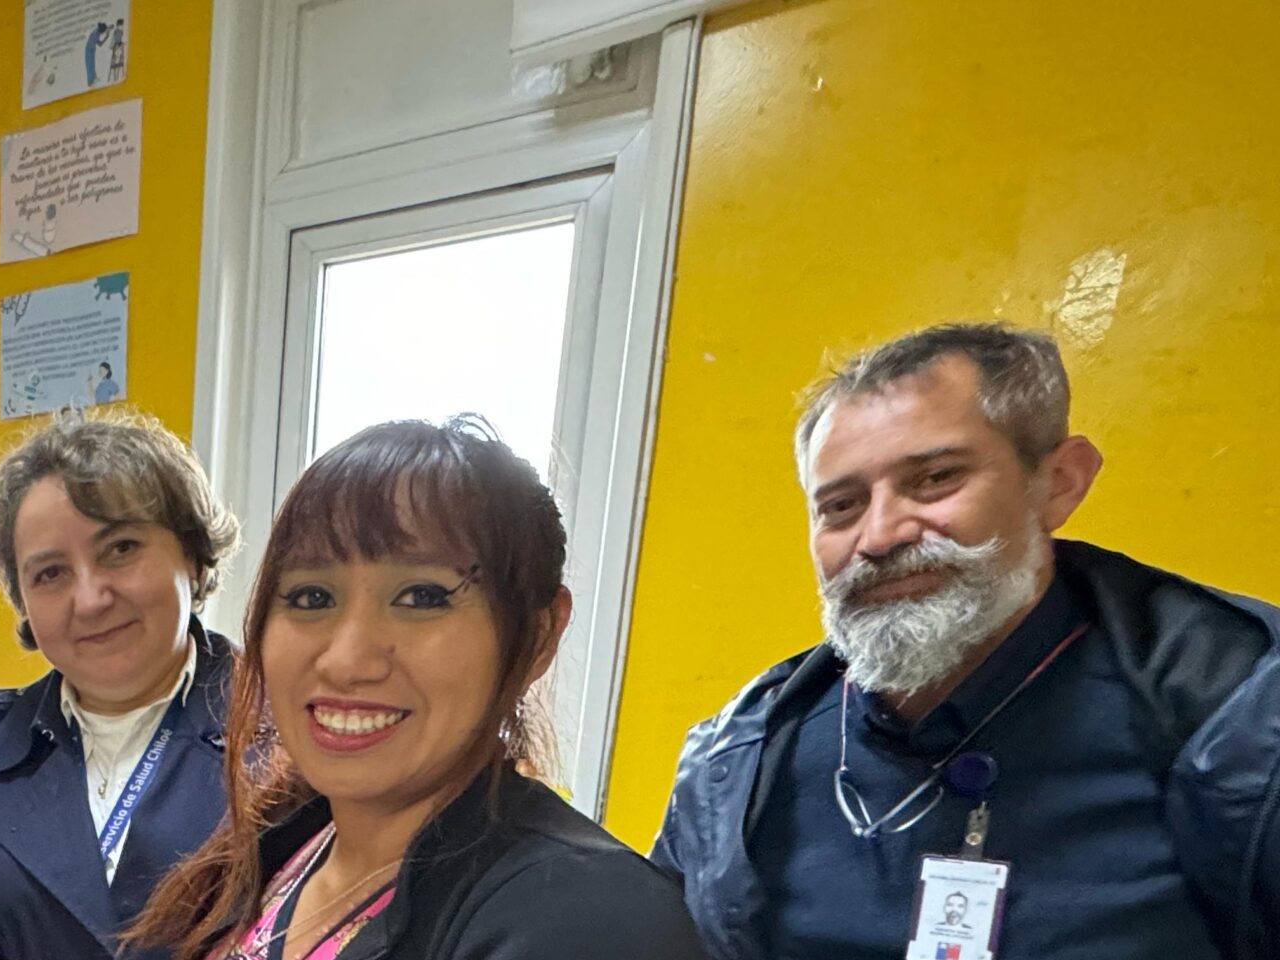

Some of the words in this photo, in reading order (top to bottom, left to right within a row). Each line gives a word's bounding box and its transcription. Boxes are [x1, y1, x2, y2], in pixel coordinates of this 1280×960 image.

[122, 794, 136, 808] de
[129, 762, 154, 792] Salud
[147, 728, 173, 761] Chiloé
